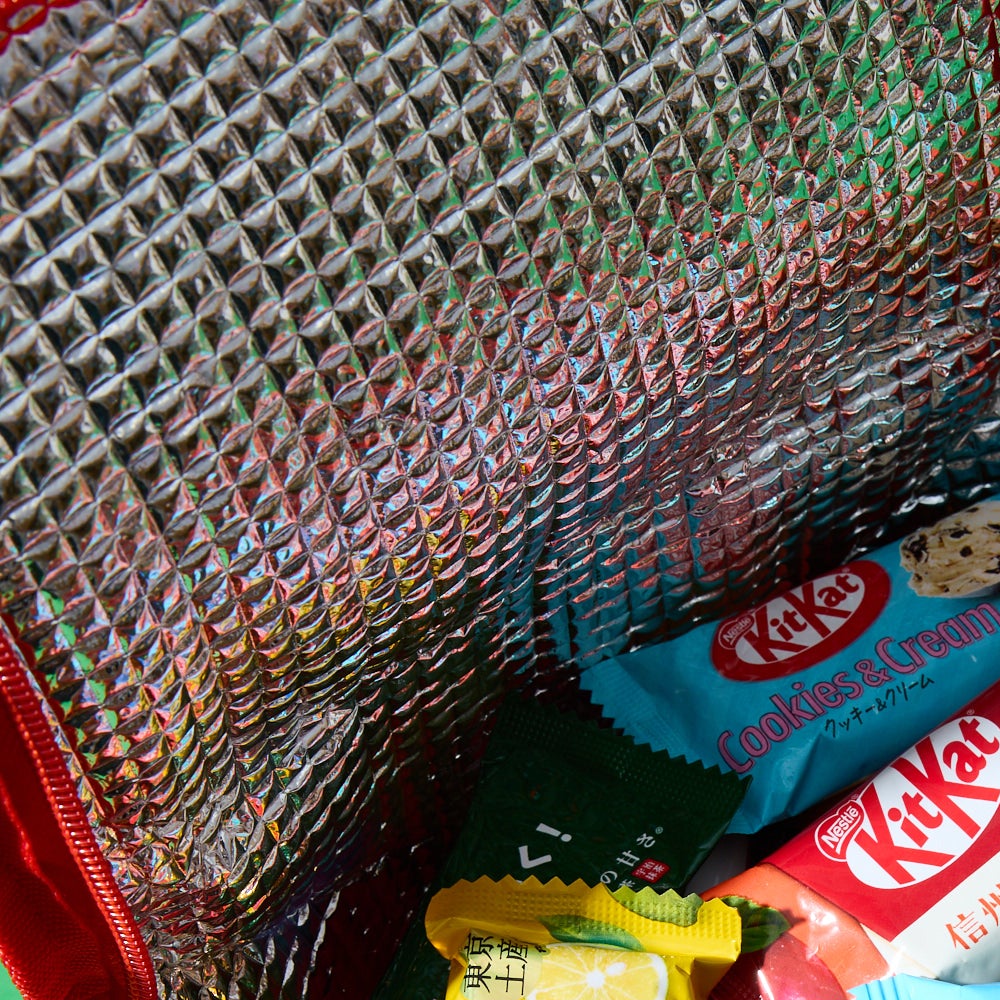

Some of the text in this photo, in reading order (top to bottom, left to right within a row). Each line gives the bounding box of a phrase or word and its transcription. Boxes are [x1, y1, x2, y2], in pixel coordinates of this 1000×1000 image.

[744, 574, 860, 664] KitKat
[717, 670, 865, 774] Cookies
[853, 658, 892, 687] &
